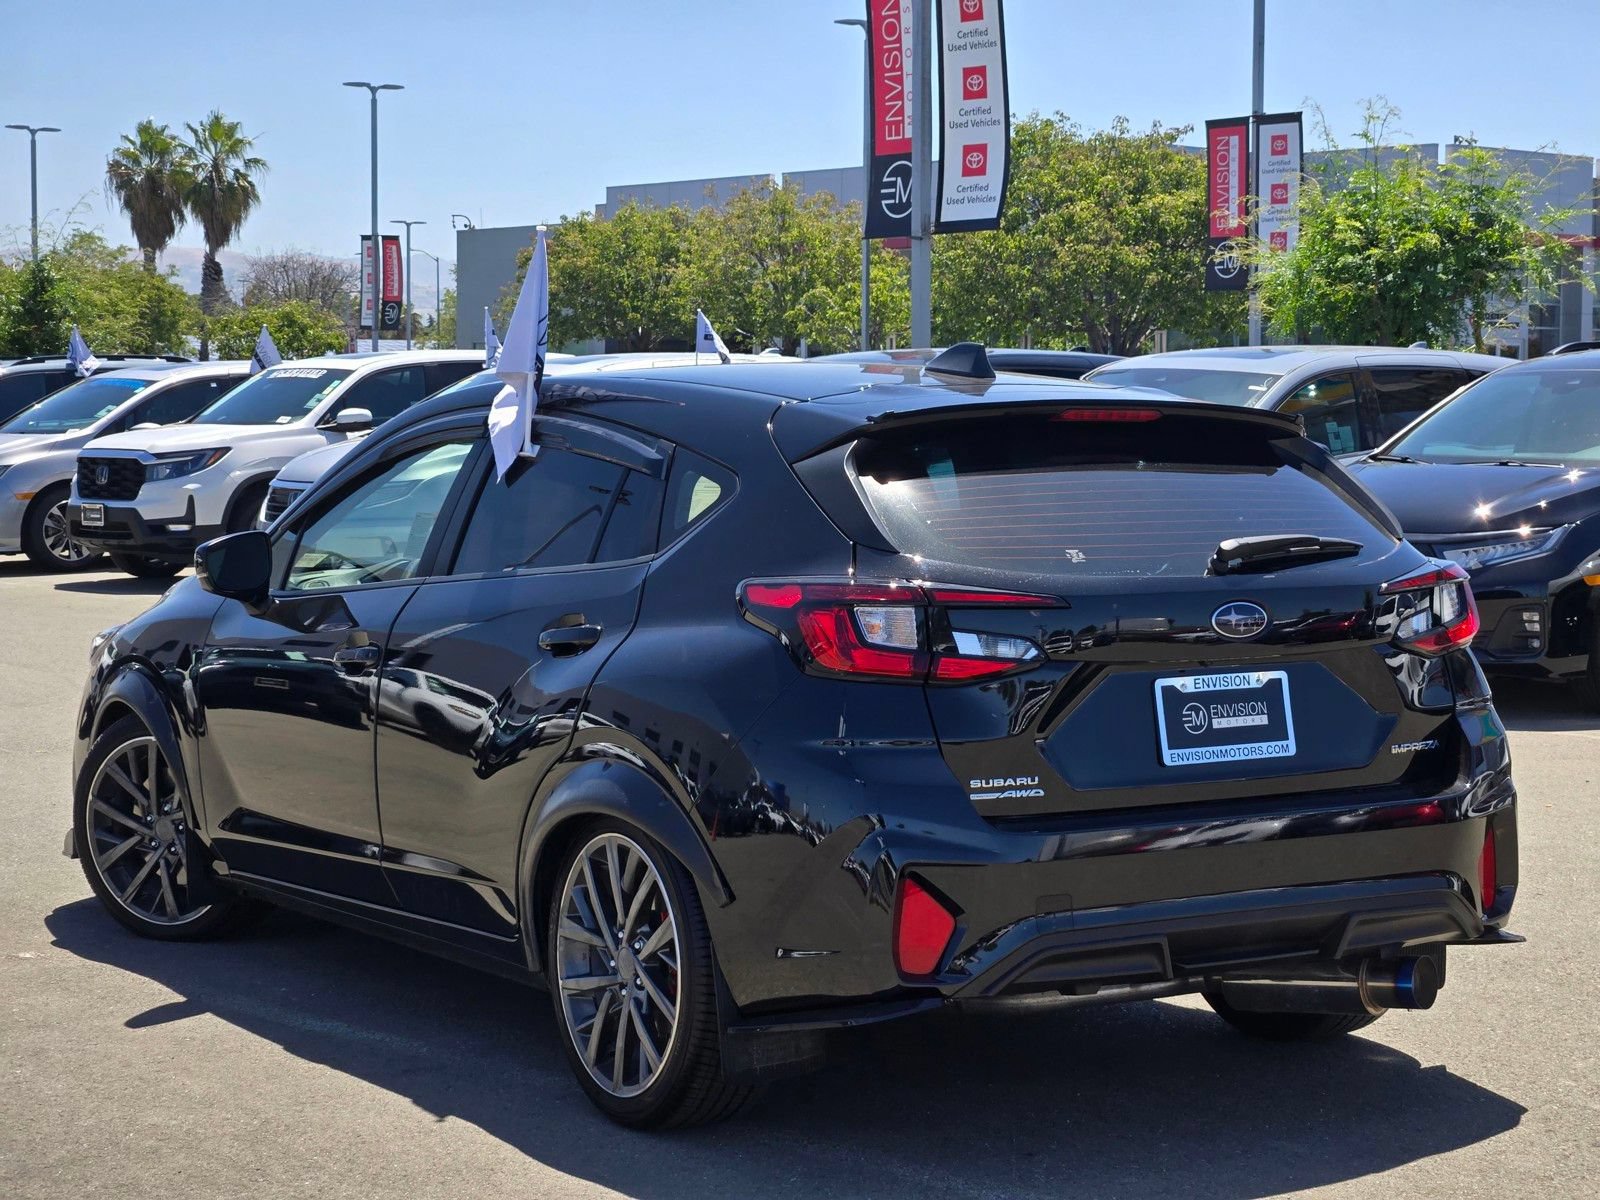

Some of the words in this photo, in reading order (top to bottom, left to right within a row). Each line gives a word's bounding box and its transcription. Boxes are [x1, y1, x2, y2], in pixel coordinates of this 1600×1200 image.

[957, 27, 989, 39] Certified
[947, 42, 968, 52] Used
[969, 39, 998, 50] Vehicles
[881, 0, 903, 141] ENVISION
[958, 107, 992, 117] Certified
[949, 119, 970, 129] Used
[971, 118, 1001, 128] Vehicles
[1267, 159, 1291, 167] Certified
[956, 183, 989, 194] Certified
[946, 196, 965, 205] Used
[966, 194, 996, 204] Vehicles
[1193, 674, 1250, 690] ENVISION
[1210, 701, 1268, 718] ENVISION
[1216, 717, 1264, 726] MOTORS
[1170, 743, 1290, 763] ENVISIONMOTORS.COM
[969, 776, 1039, 788] SUBARU
[998, 788, 1045, 798] AWD
